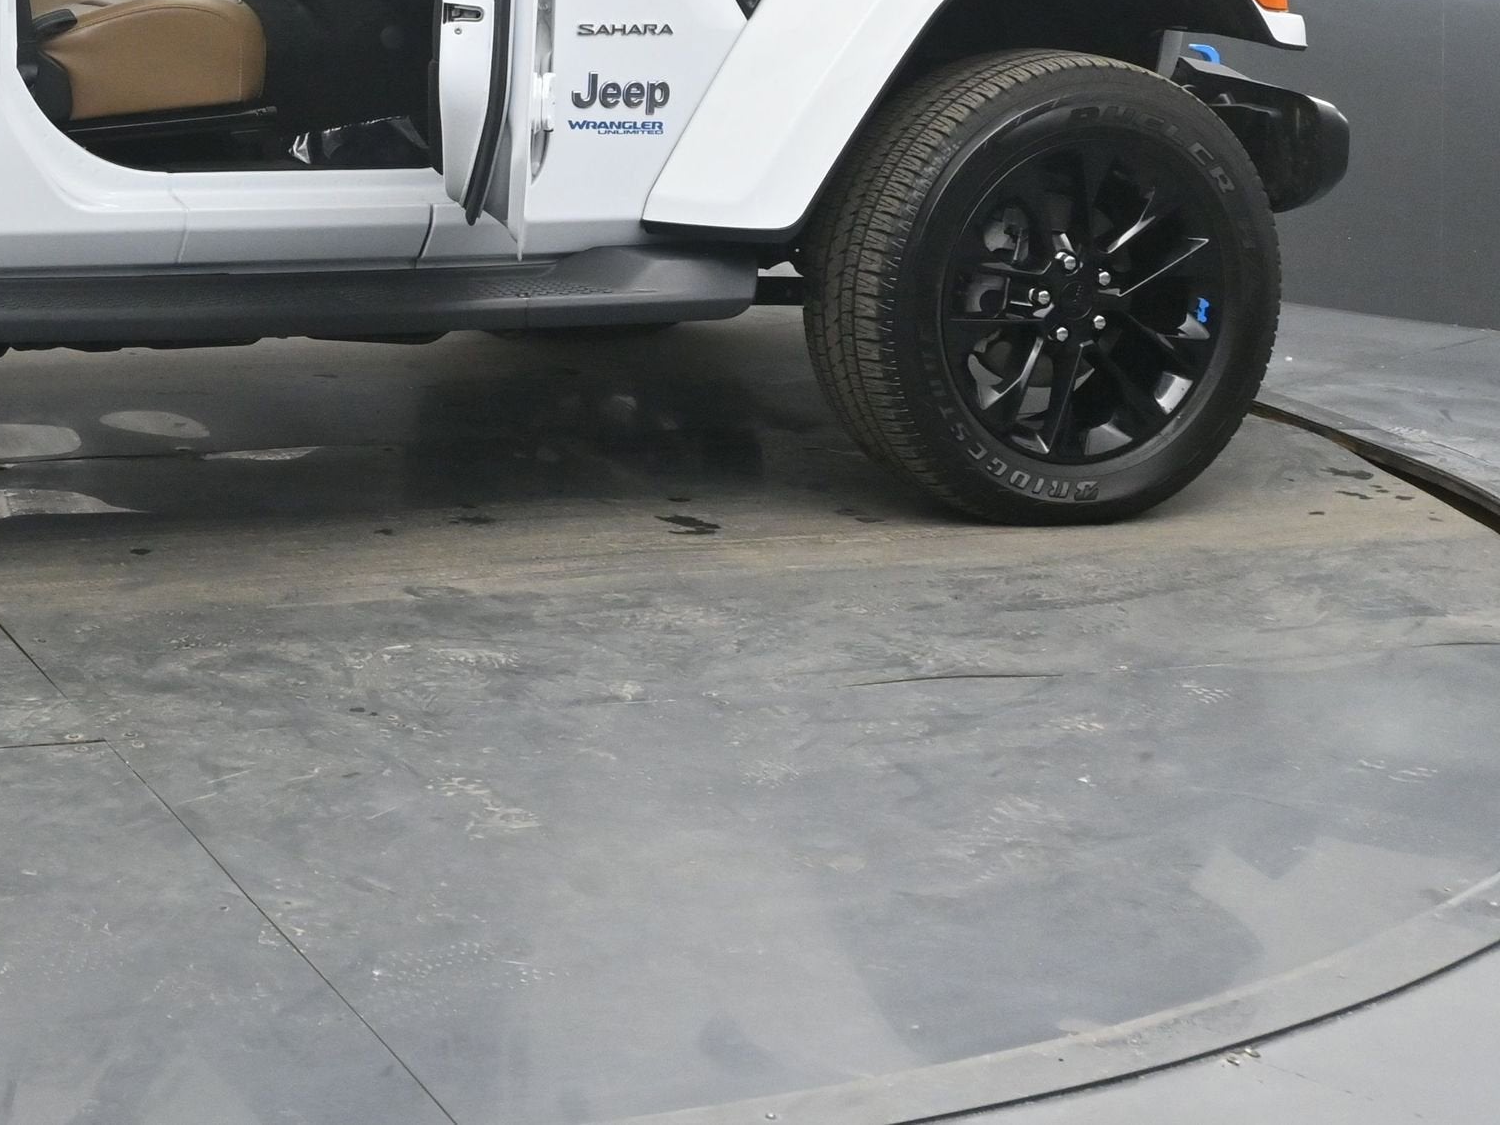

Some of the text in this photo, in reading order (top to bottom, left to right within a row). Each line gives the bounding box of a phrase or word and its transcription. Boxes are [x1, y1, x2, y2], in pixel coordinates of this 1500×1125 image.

[577, 24, 674, 36] SAHARA
[571, 71, 670, 115] Jeep
[568, 120, 664, 130] WRANGLER
